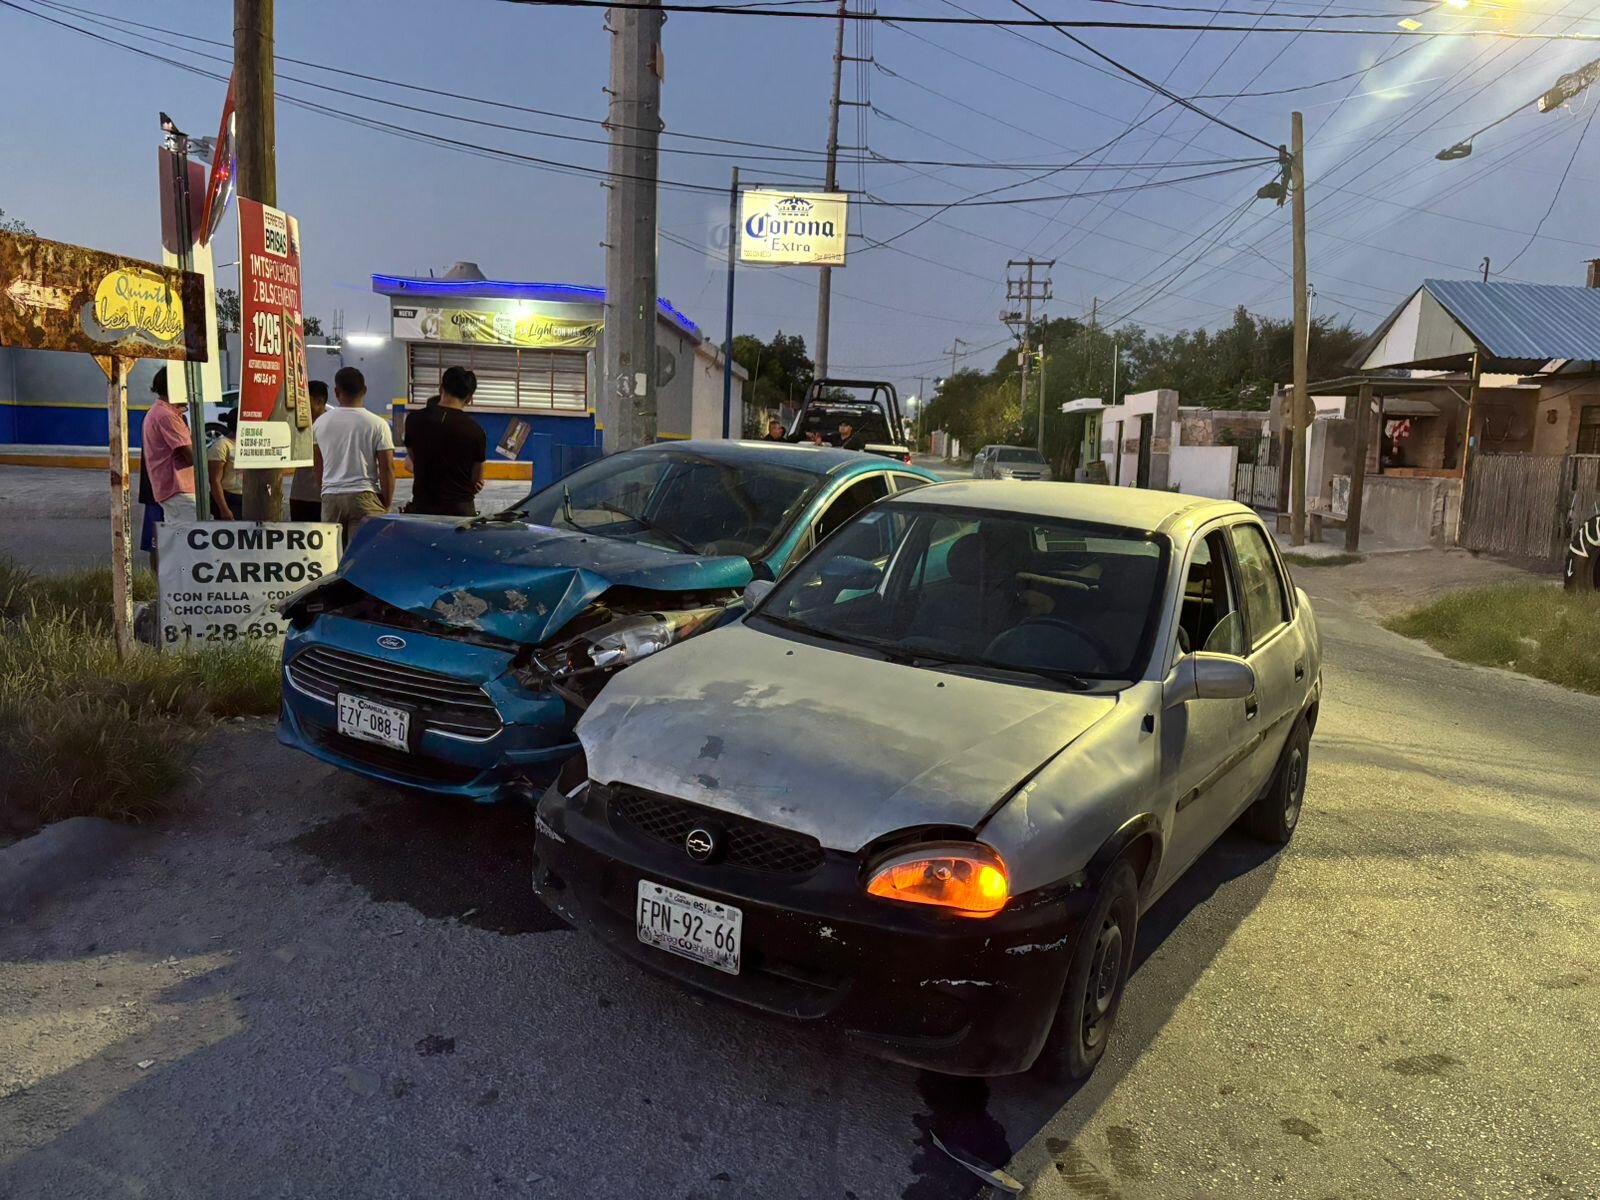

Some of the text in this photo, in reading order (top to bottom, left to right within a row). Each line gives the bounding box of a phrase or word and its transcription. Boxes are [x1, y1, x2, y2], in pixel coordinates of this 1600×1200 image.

[745, 212, 835, 242] Corona
[265, 228, 287, 255] BRISAS
[771, 237, 812, 252] Extra
[100, 296, 130, 327] Los
[398, 309, 415, 318] NUEVA
[528, 322, 555, 341] Light
[553, 328, 567, 337] CON
[187, 528, 324, 550] COMPRO
[191, 561, 323, 583] CARROS
[207, 591, 249, 601] FALLA
[640, 897, 736, 953] FPN-92-66
